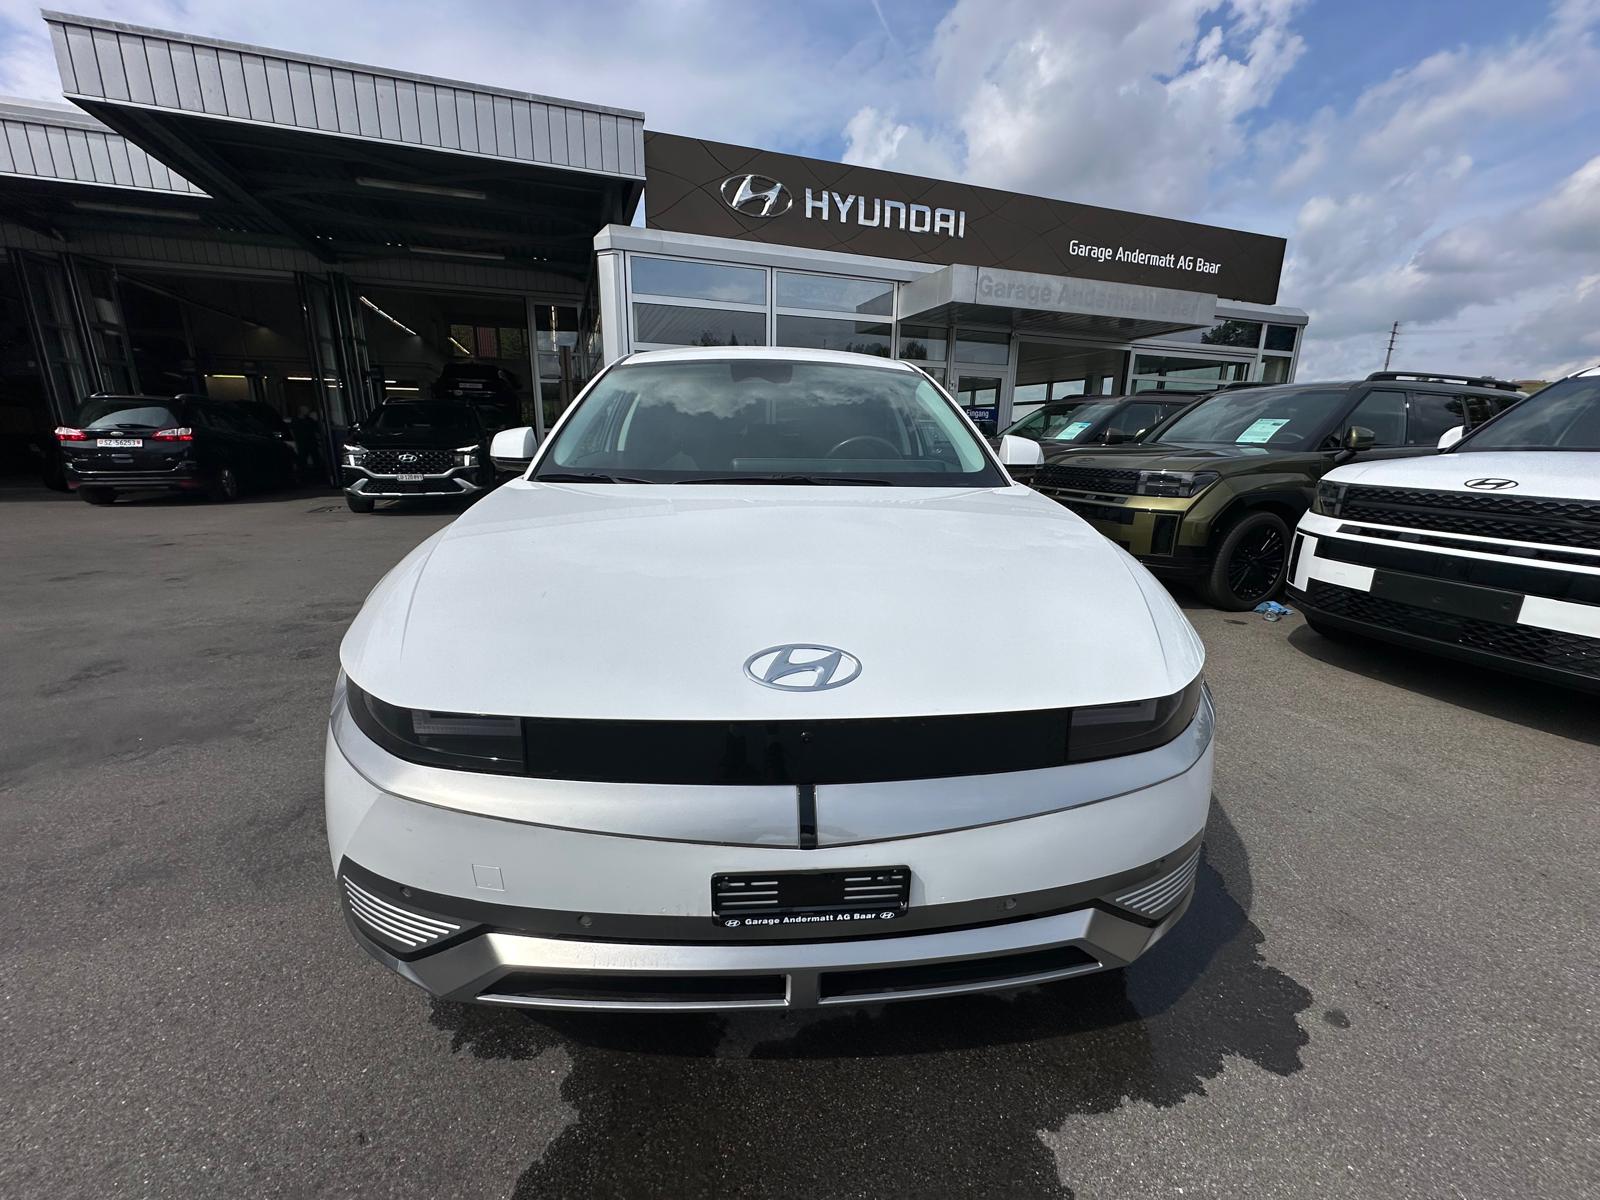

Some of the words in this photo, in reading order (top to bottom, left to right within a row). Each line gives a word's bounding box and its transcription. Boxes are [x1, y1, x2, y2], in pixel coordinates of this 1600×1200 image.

[805, 187, 966, 239] HYUNDAI
[1069, 239, 1113, 263] Garage
[1115, 246, 1175, 269] Andermatt
[1176, 255, 1194, 271] AG
[1195, 257, 1222, 274] Baar
[978, 273, 1053, 305] Garage
[744, 918, 780, 926] Garage
[783, 915, 834, 924] Andermatt
[836, 913, 851, 921] AG
[853, 912, 876, 920] Baar
